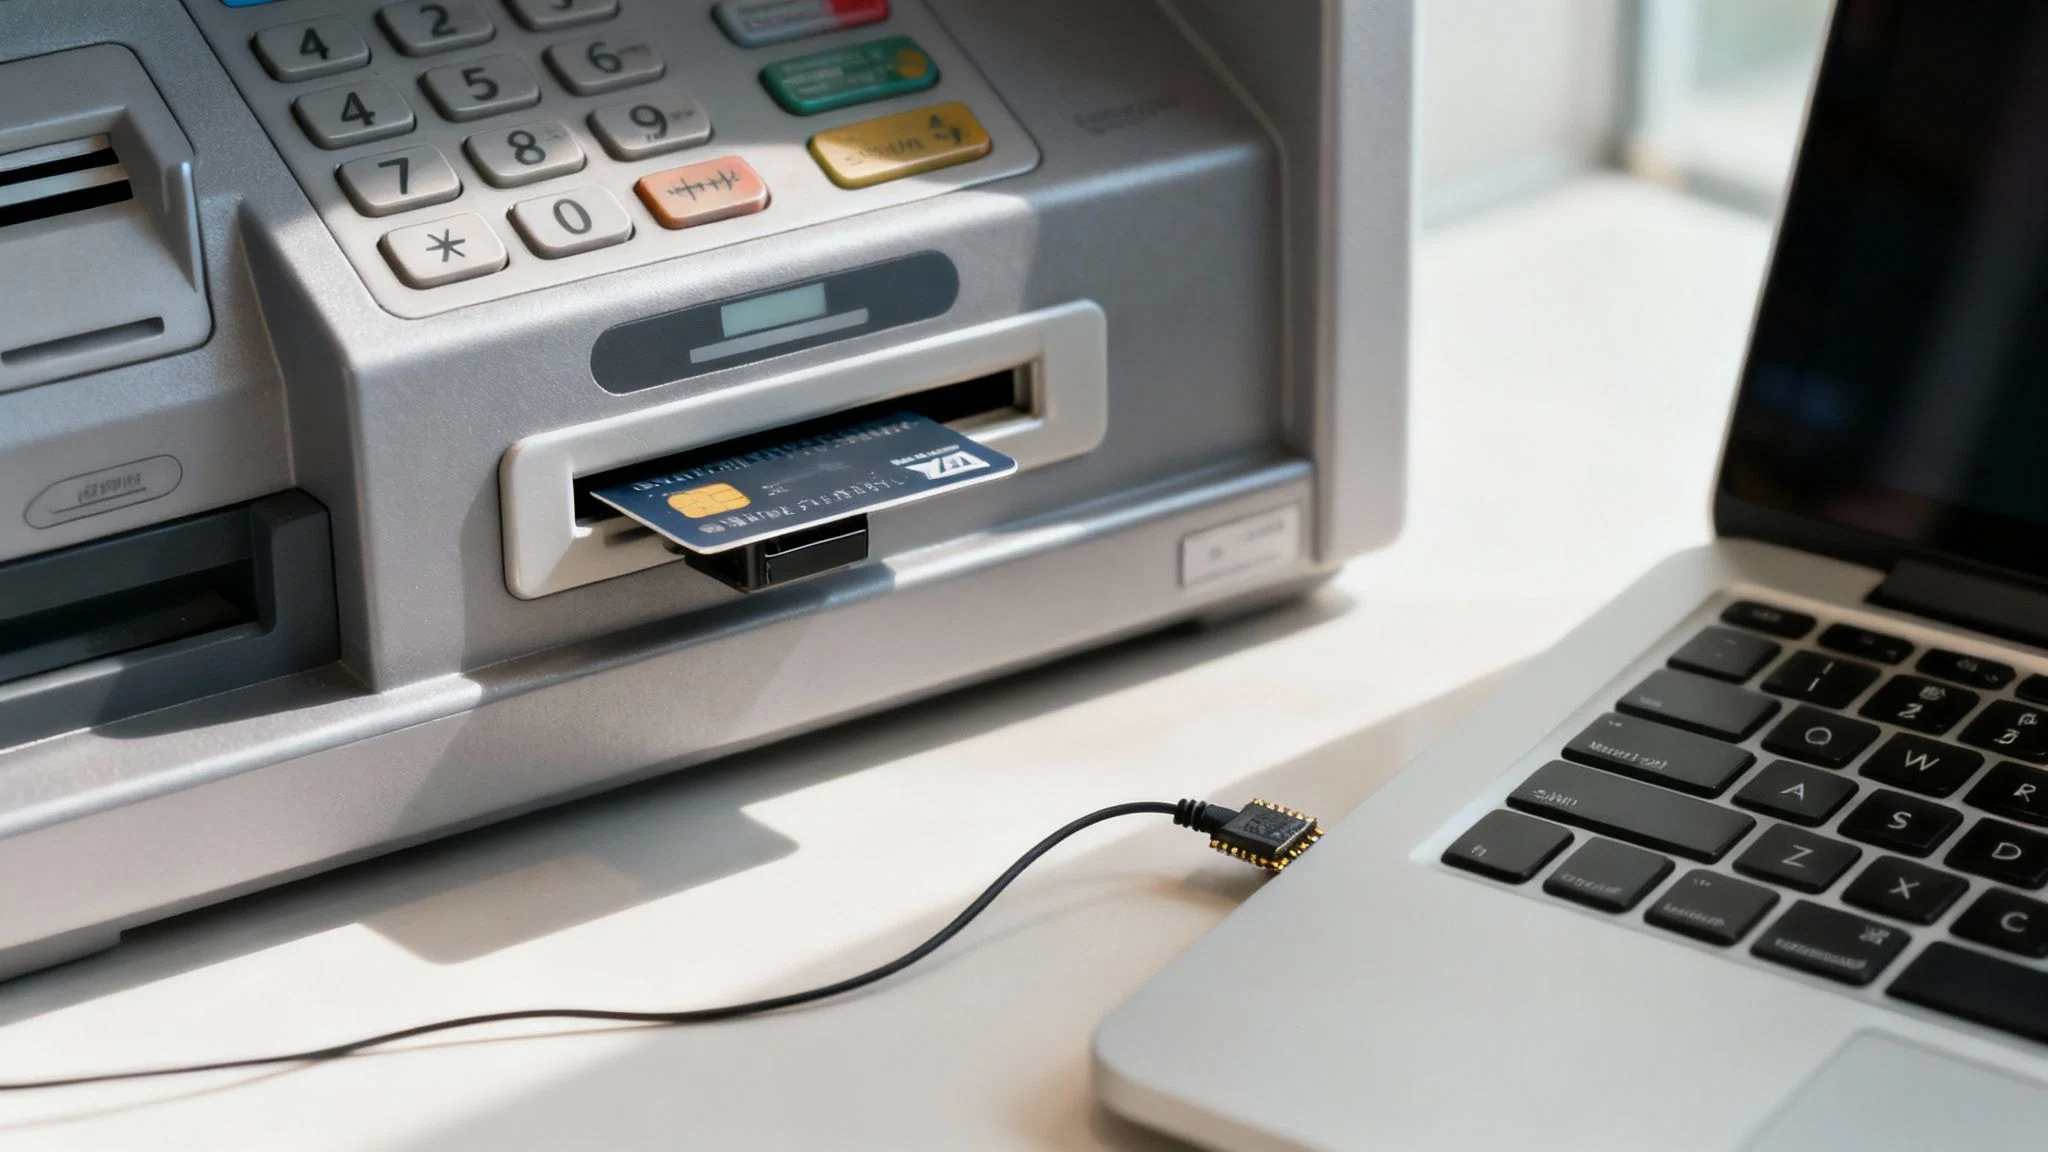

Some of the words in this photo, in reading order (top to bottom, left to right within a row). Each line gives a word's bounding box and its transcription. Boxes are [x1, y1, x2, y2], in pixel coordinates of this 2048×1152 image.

[419, 4, 457, 38] 2
[299, 27, 329, 60] 4
[587, 41, 622, 74] 6
[461, 67, 498, 101] 5
[340, 92, 376, 126] 4
[629, 104, 668, 138] 9
[507, 130, 546, 165] 8
[378, 157, 410, 195] 7
[553, 198, 592, 235] 0
[1904, 749, 1940, 772] W
[1779, 783, 1805, 801] A
[2013, 783, 2037, 802] R
[1887, 811, 1912, 830] S
[1781, 844, 1814, 868] Z
[1991, 842, 2022, 860] D
[1888, 876, 1920, 900] X
[2001, 911, 2029, 933] C
